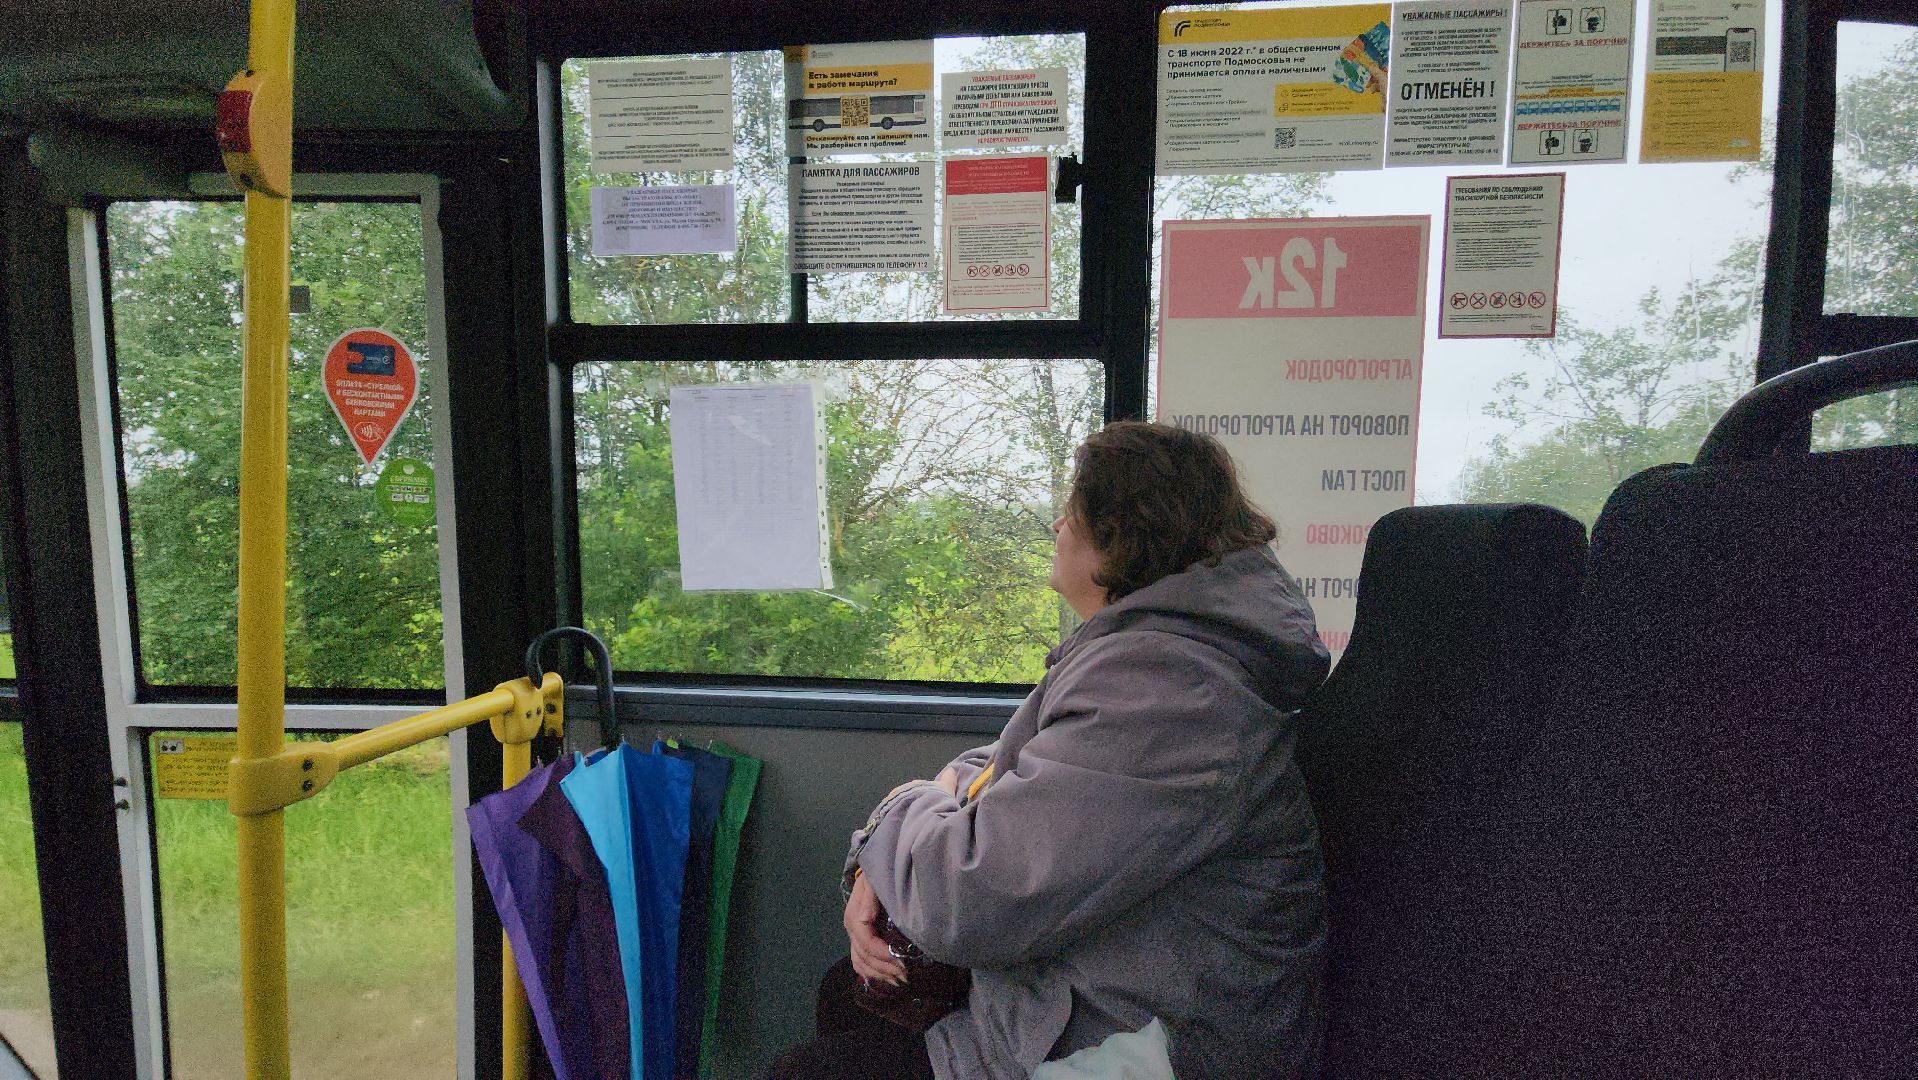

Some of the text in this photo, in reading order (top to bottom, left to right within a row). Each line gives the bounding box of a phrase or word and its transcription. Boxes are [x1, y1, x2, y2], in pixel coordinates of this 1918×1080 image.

[1402, 11, 1451, 20] УВАЖАЕМЫЕ
[1520, 41, 1570, 49] ДЕРЖИТЕСЬ
[1168, 50, 1174, 58] С
[1219, 47, 1244, 56] 2022
[1268, 45, 1341, 54] общественном
[1168, 60, 1222, 70] транспорте
[1224, 57, 1290, 67] Подмосковья
[808, 70, 879, 80] Есть замечания
[1168, 66, 1326, 80] принимается оплата наличными
[816, 81, 846, 89] работе
[848, 78, 898, 88] маршрута?
[1400, 78, 1485, 100] ОТМЕНЁН
[1490, 80, 1494, 98] !
[990, 100, 1002, 108] ДТП
[870, 140, 906, 148] проблеме!
[802, 166, 920, 178] ПАМЯТКА ДЛЯ ПАССАЖИРОВ
[826, 262, 830, 270] О
[886, 261, 916, 269] ТЕЛЕФОНУ
[336, 380, 362, 388] ОПЛАТА
[342, 390, 404, 400] БЕСКОНТАКТНЫМИ
[346, 399, 394, 408] БАНКОВСКИМИ
